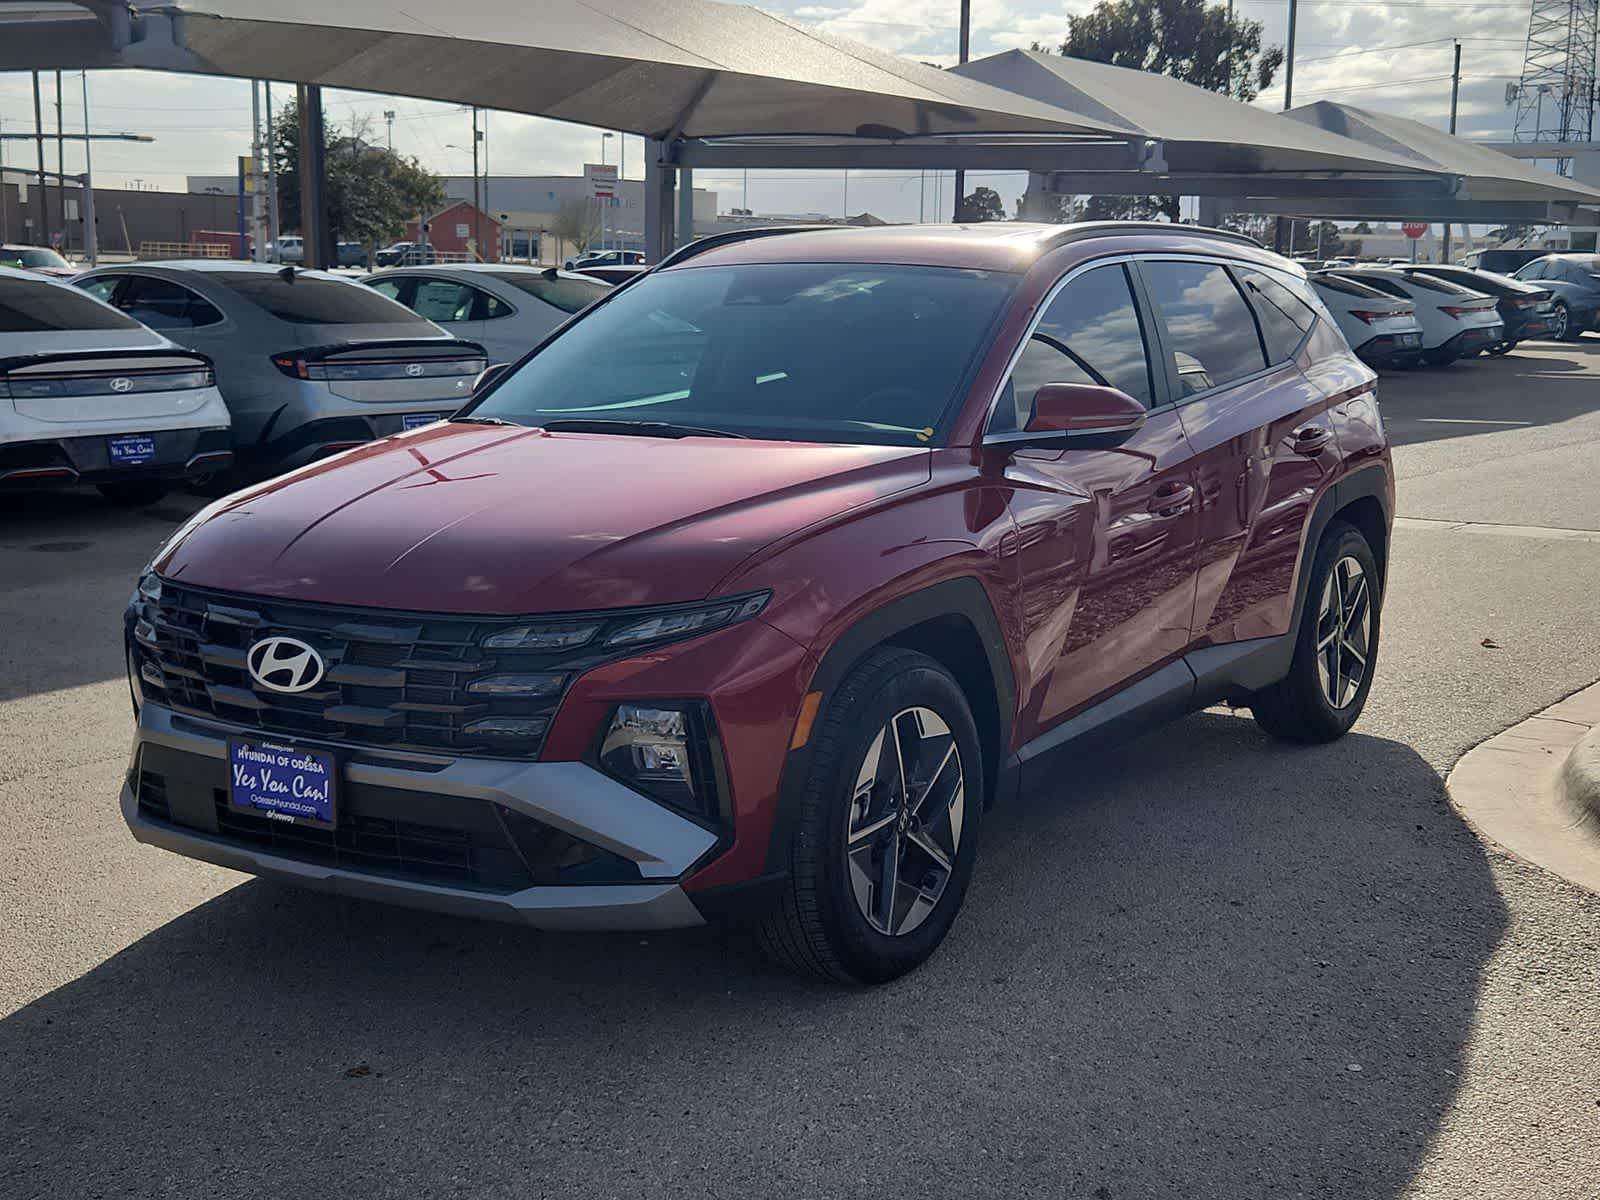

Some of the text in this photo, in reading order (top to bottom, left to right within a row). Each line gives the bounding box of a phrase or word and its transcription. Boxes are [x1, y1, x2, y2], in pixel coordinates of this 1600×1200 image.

[238, 749, 324, 774] HYUNDAI OF ODESSA
[233, 764, 329, 803] Yes You Can!
